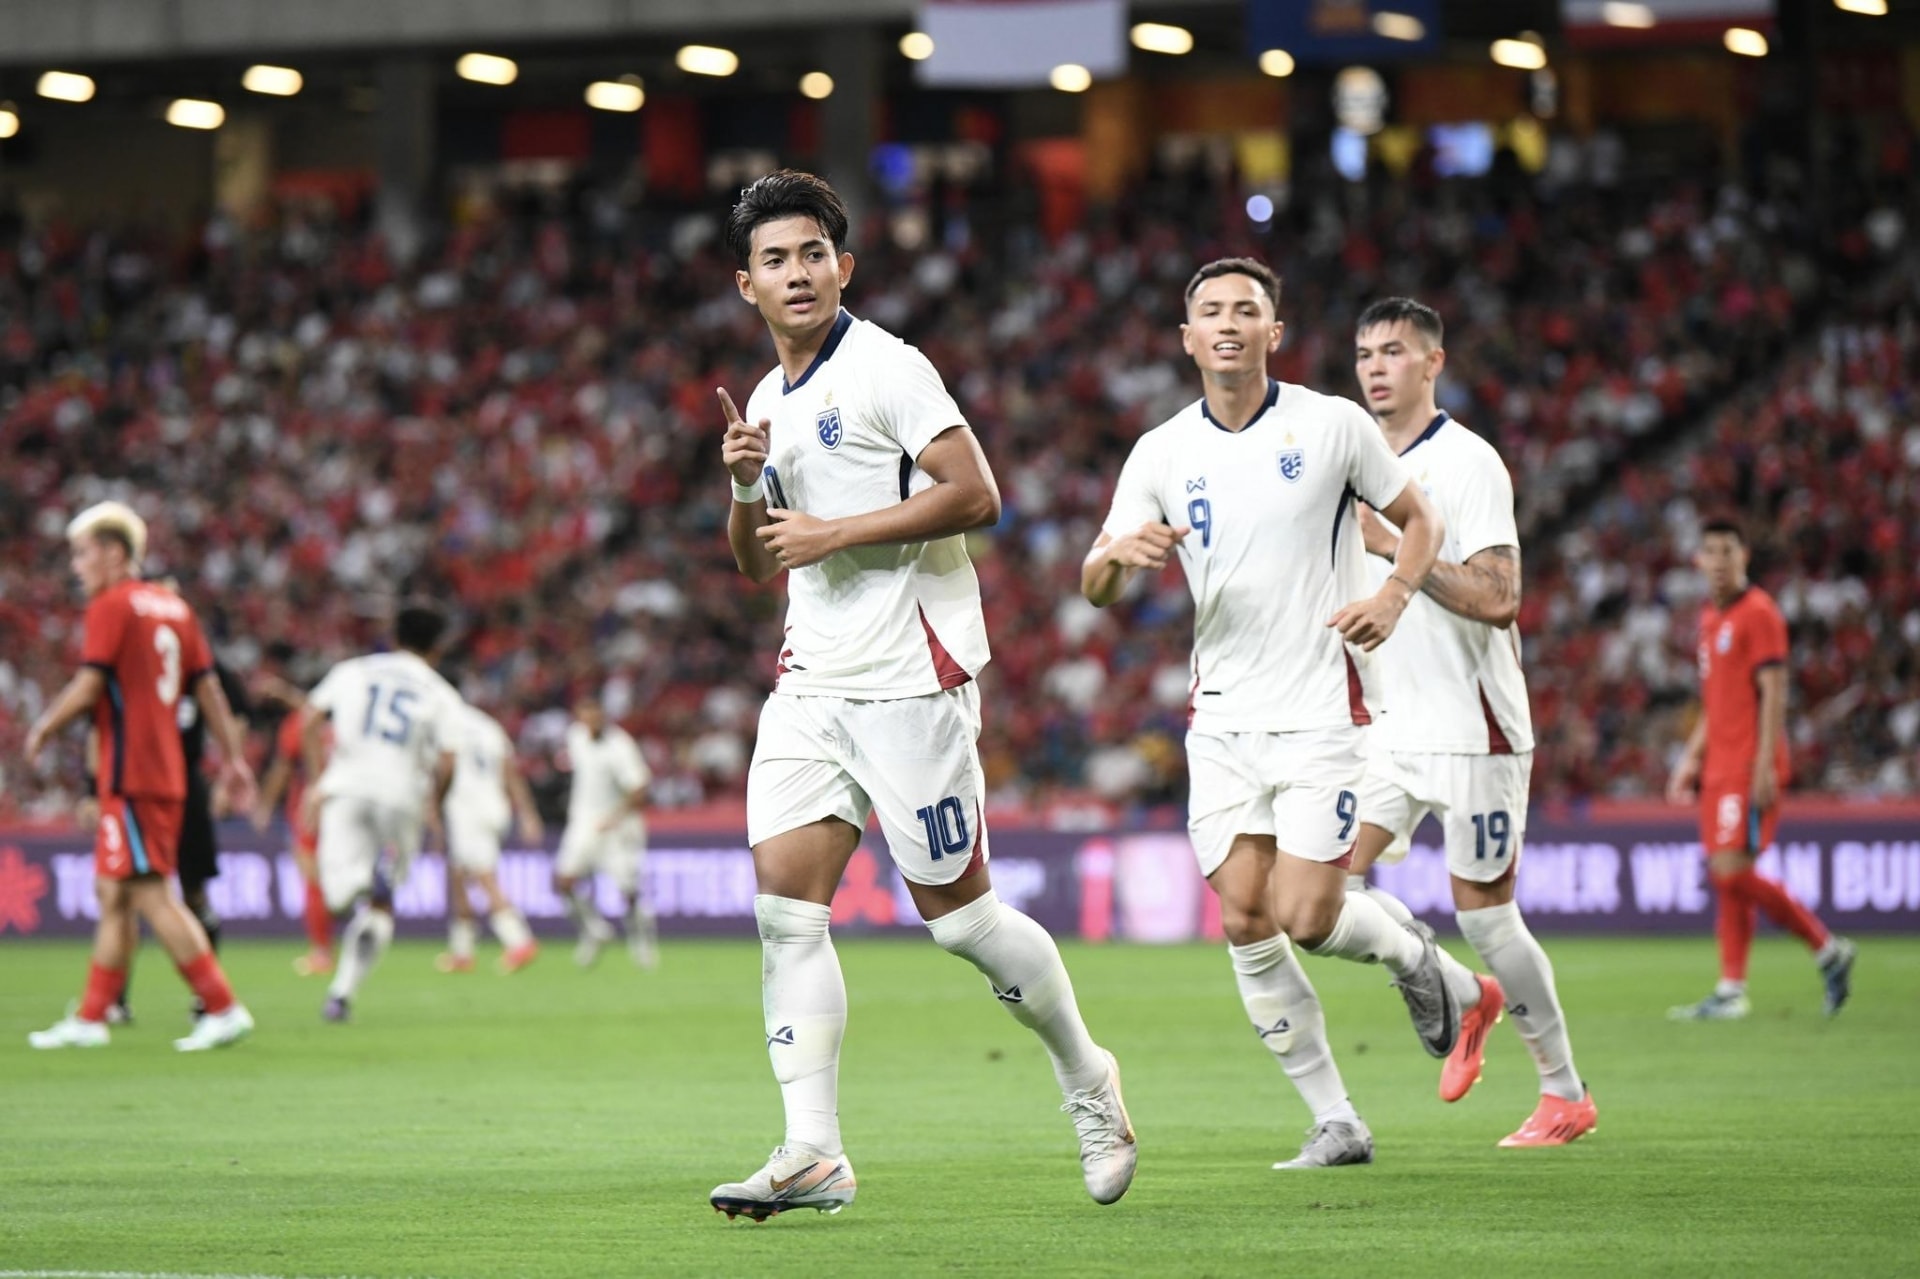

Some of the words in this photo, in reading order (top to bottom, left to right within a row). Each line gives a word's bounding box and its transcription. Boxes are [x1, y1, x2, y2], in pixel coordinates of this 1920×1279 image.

[1188, 498, 1211, 548] 9
[153, 623, 181, 706] 3
[362, 683, 418, 746] 15
[916, 795, 970, 861] 10
[1336, 790, 1357, 840] 9
[1471, 810, 1510, 860] 19
